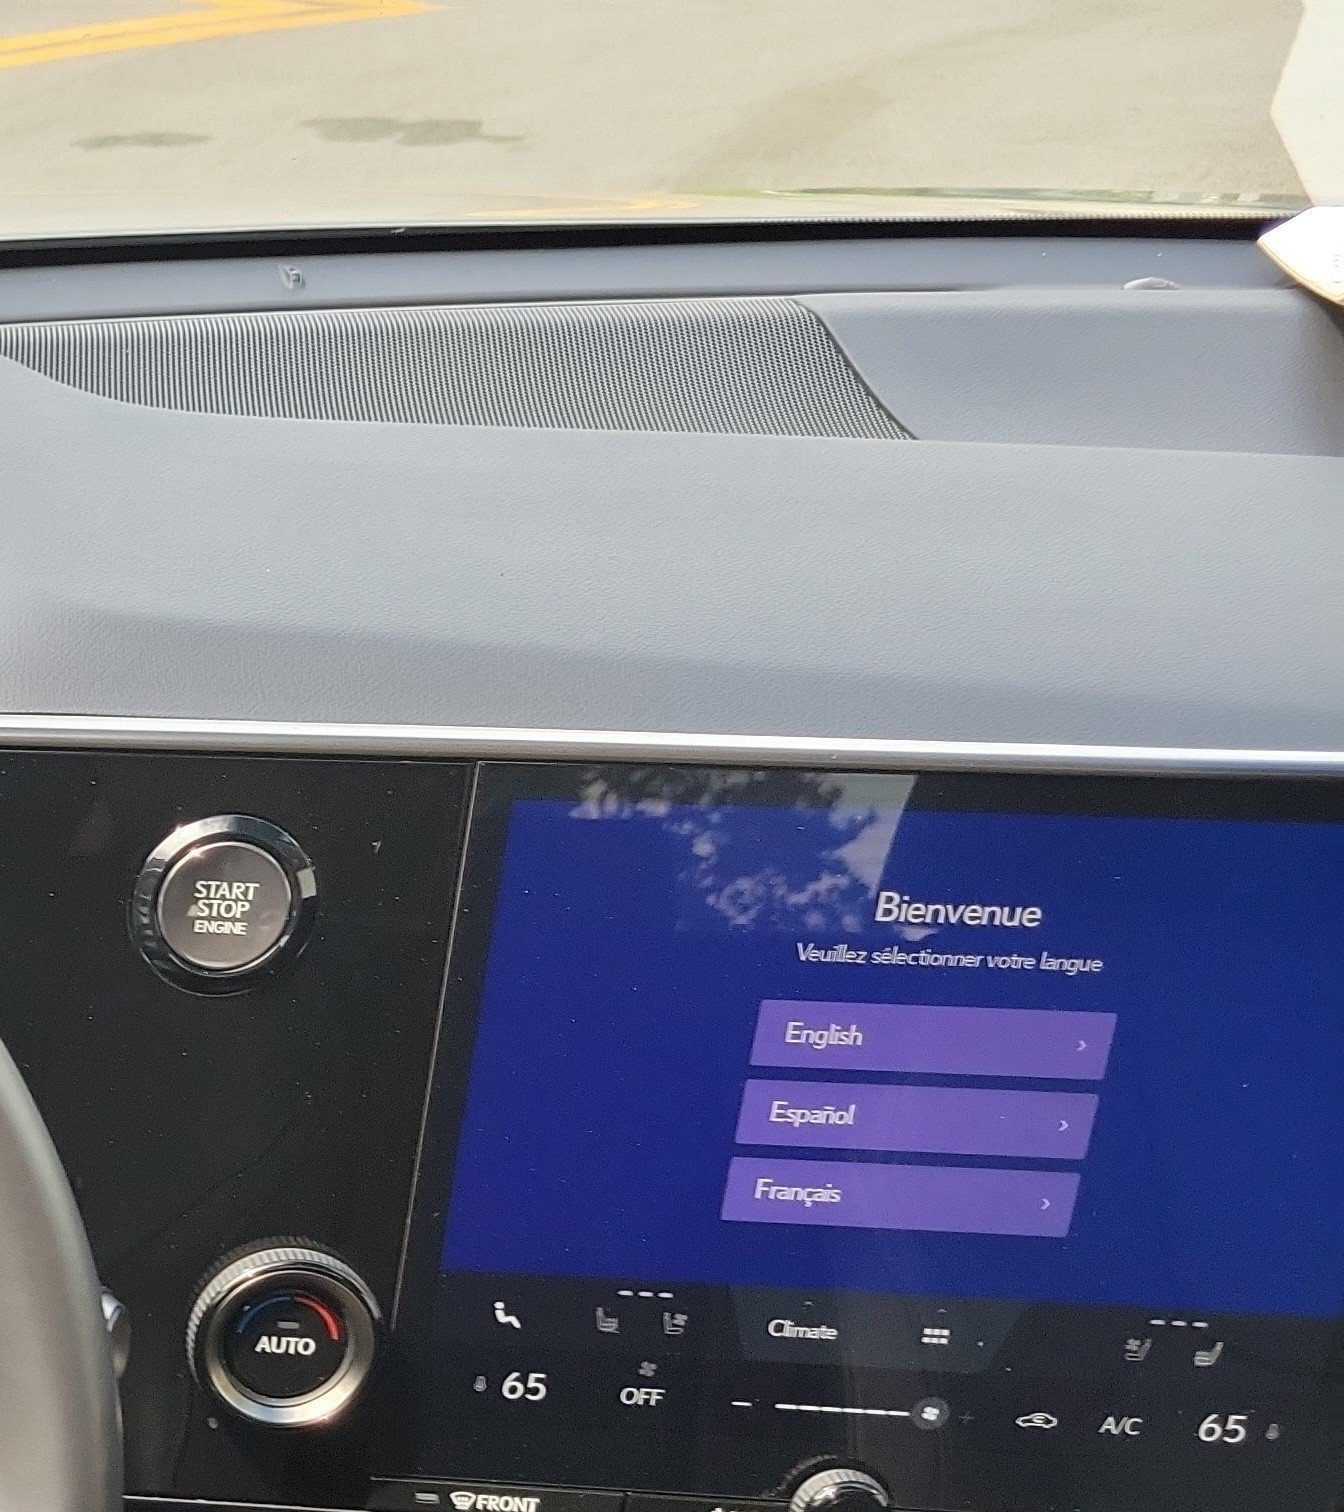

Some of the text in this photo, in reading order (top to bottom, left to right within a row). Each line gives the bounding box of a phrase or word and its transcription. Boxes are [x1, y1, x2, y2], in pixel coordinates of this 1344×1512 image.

[194, 880, 260, 901] START
[197, 900, 250, 918] STOP
[874, 891, 1042, 927] Bienvenue
[193, 919, 248, 936] ENGINE
[797, 942, 1104, 977] Veuillez sélectionner votre langue
[785, 1021, 863, 1050] English
[769, 1100, 856, 1128] Español
[754, 1178, 842, 1208] Français
[767, 1319, 838, 1341] Climate
[255, 1335, 316, 1355] AUTO
[501, 1372, 548, 1401] 65
[620, 1387, 665, 1406] OFF
[1099, 1415, 1145, 1437] A/C
[1196, 1413, 1248, 1444] 65
